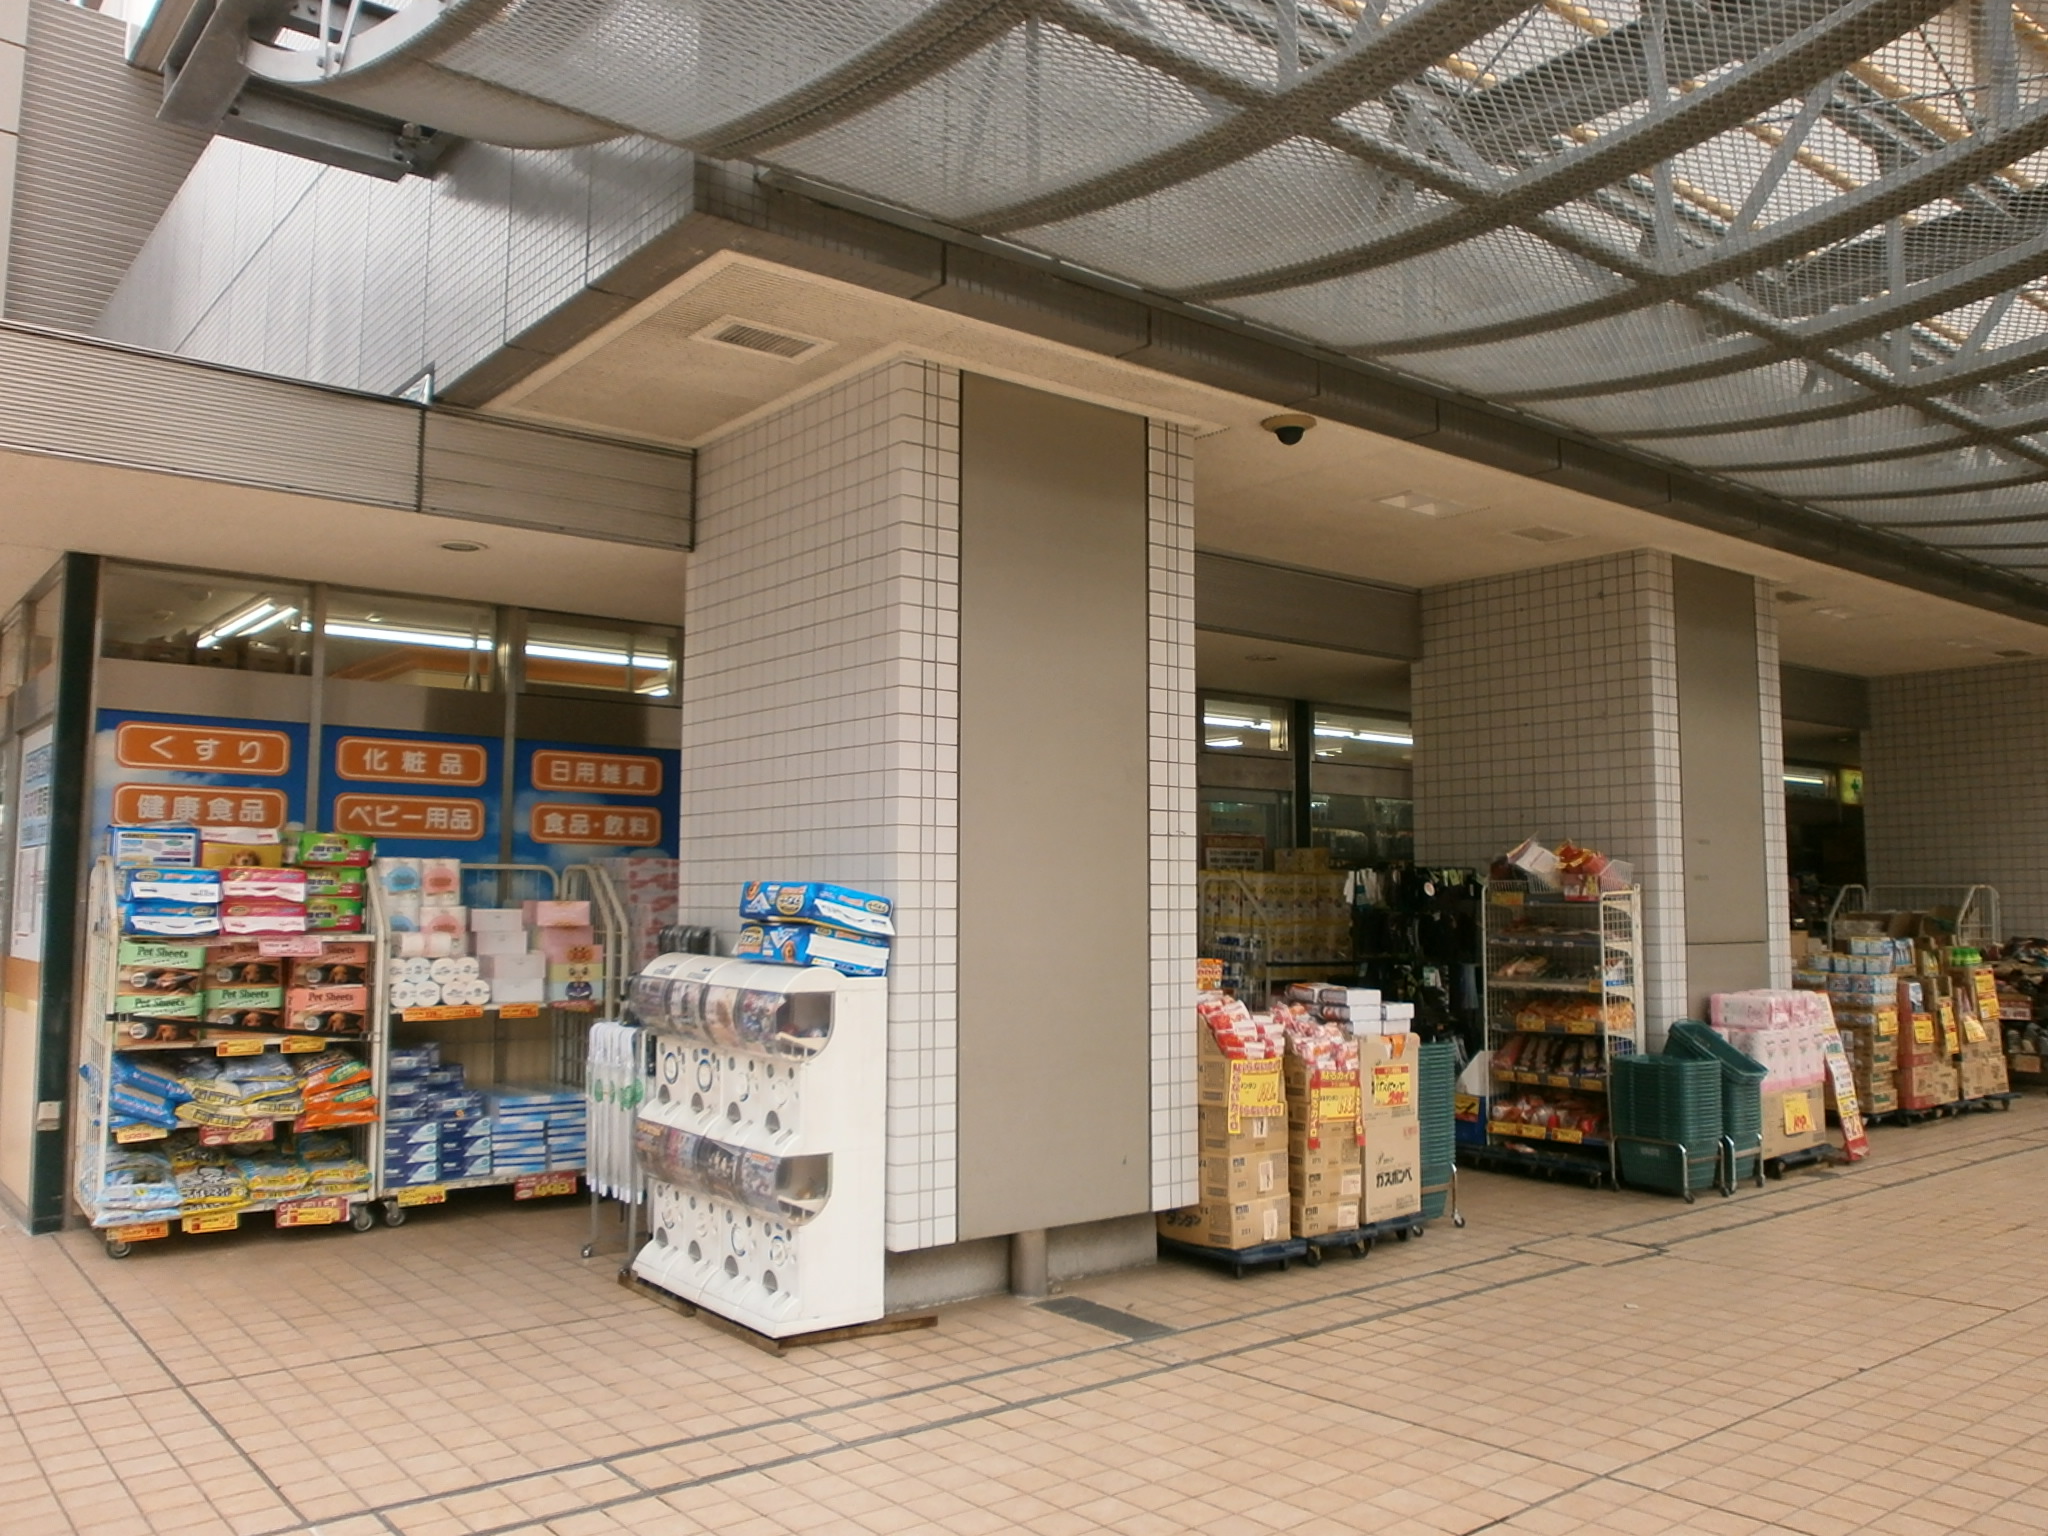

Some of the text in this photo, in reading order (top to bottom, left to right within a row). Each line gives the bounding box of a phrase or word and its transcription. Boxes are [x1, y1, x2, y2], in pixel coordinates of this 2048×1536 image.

[150, 735, 262, 764] くすり
[362, 747, 464, 776] 化粧品
[550, 760, 647, 787] 日用雑貨
[137, 793, 266, 823] 健康食品
[348, 805, 473, 831] ベビー用品
[543, 812, 650, 837] 食品・飲料
[137, 946, 189, 958] Pet Sheets
[221, 988, 269, 1000] Pet Sheets
[308, 992, 353, 1002] Pet Sheets
[1376, 1167, 1413, 1188] ガスボンベ
